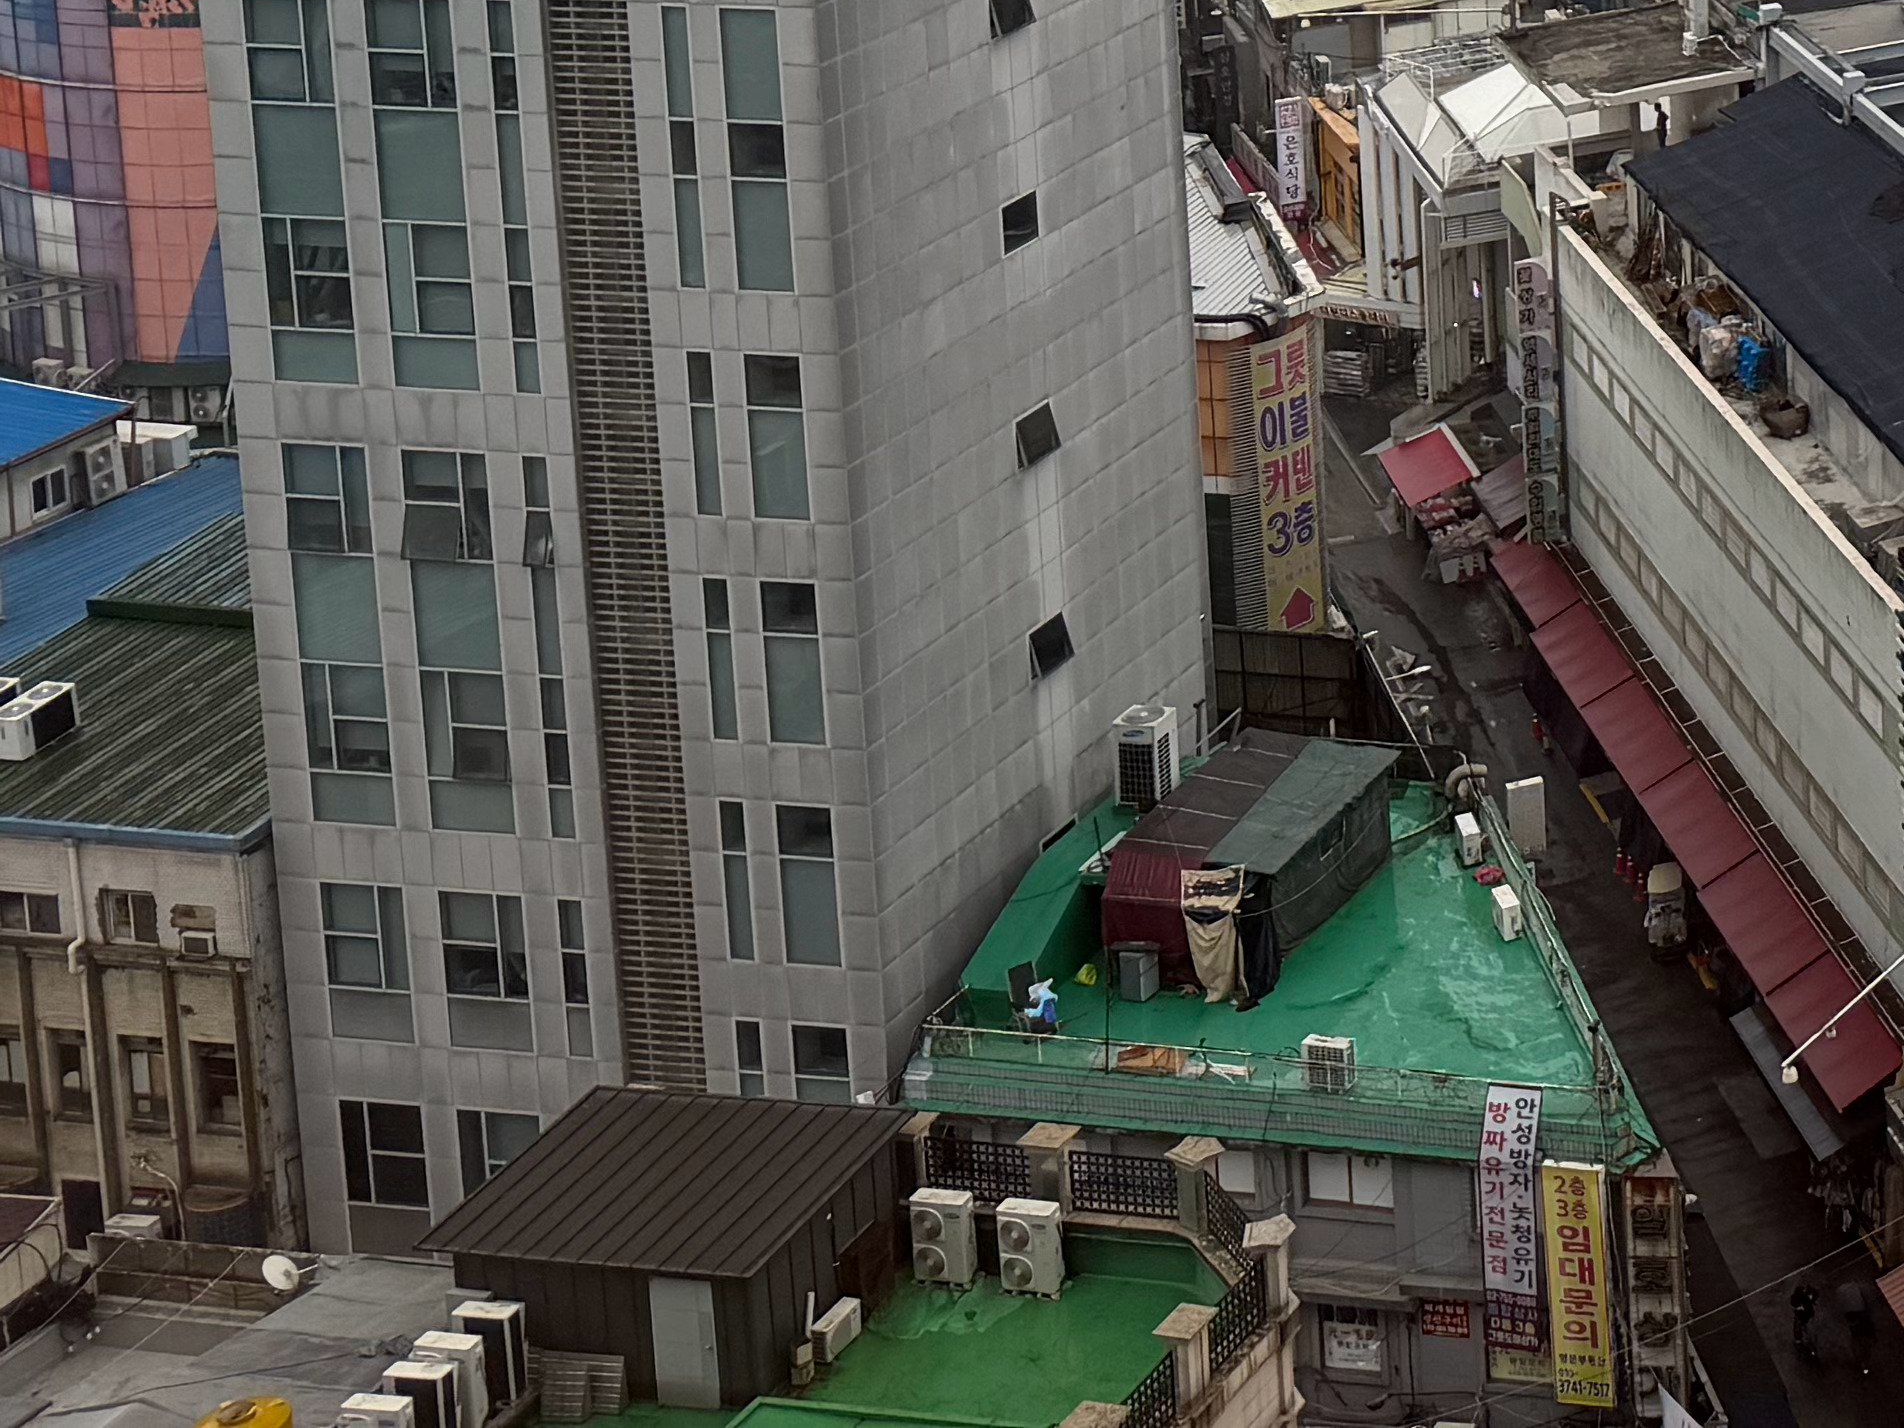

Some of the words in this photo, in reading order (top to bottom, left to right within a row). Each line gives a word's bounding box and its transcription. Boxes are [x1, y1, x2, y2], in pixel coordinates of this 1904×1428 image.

[1256, 338, 1307, 400] 그릇
[1259, 390, 1310, 453] 이불
[1266, 498, 1316, 557] 3층
[1553, 1175, 1586, 1197] 2층
[1556, 1198, 1589, 1221] 3층
[1556, 1225, 1599, 1350] 임대문의
